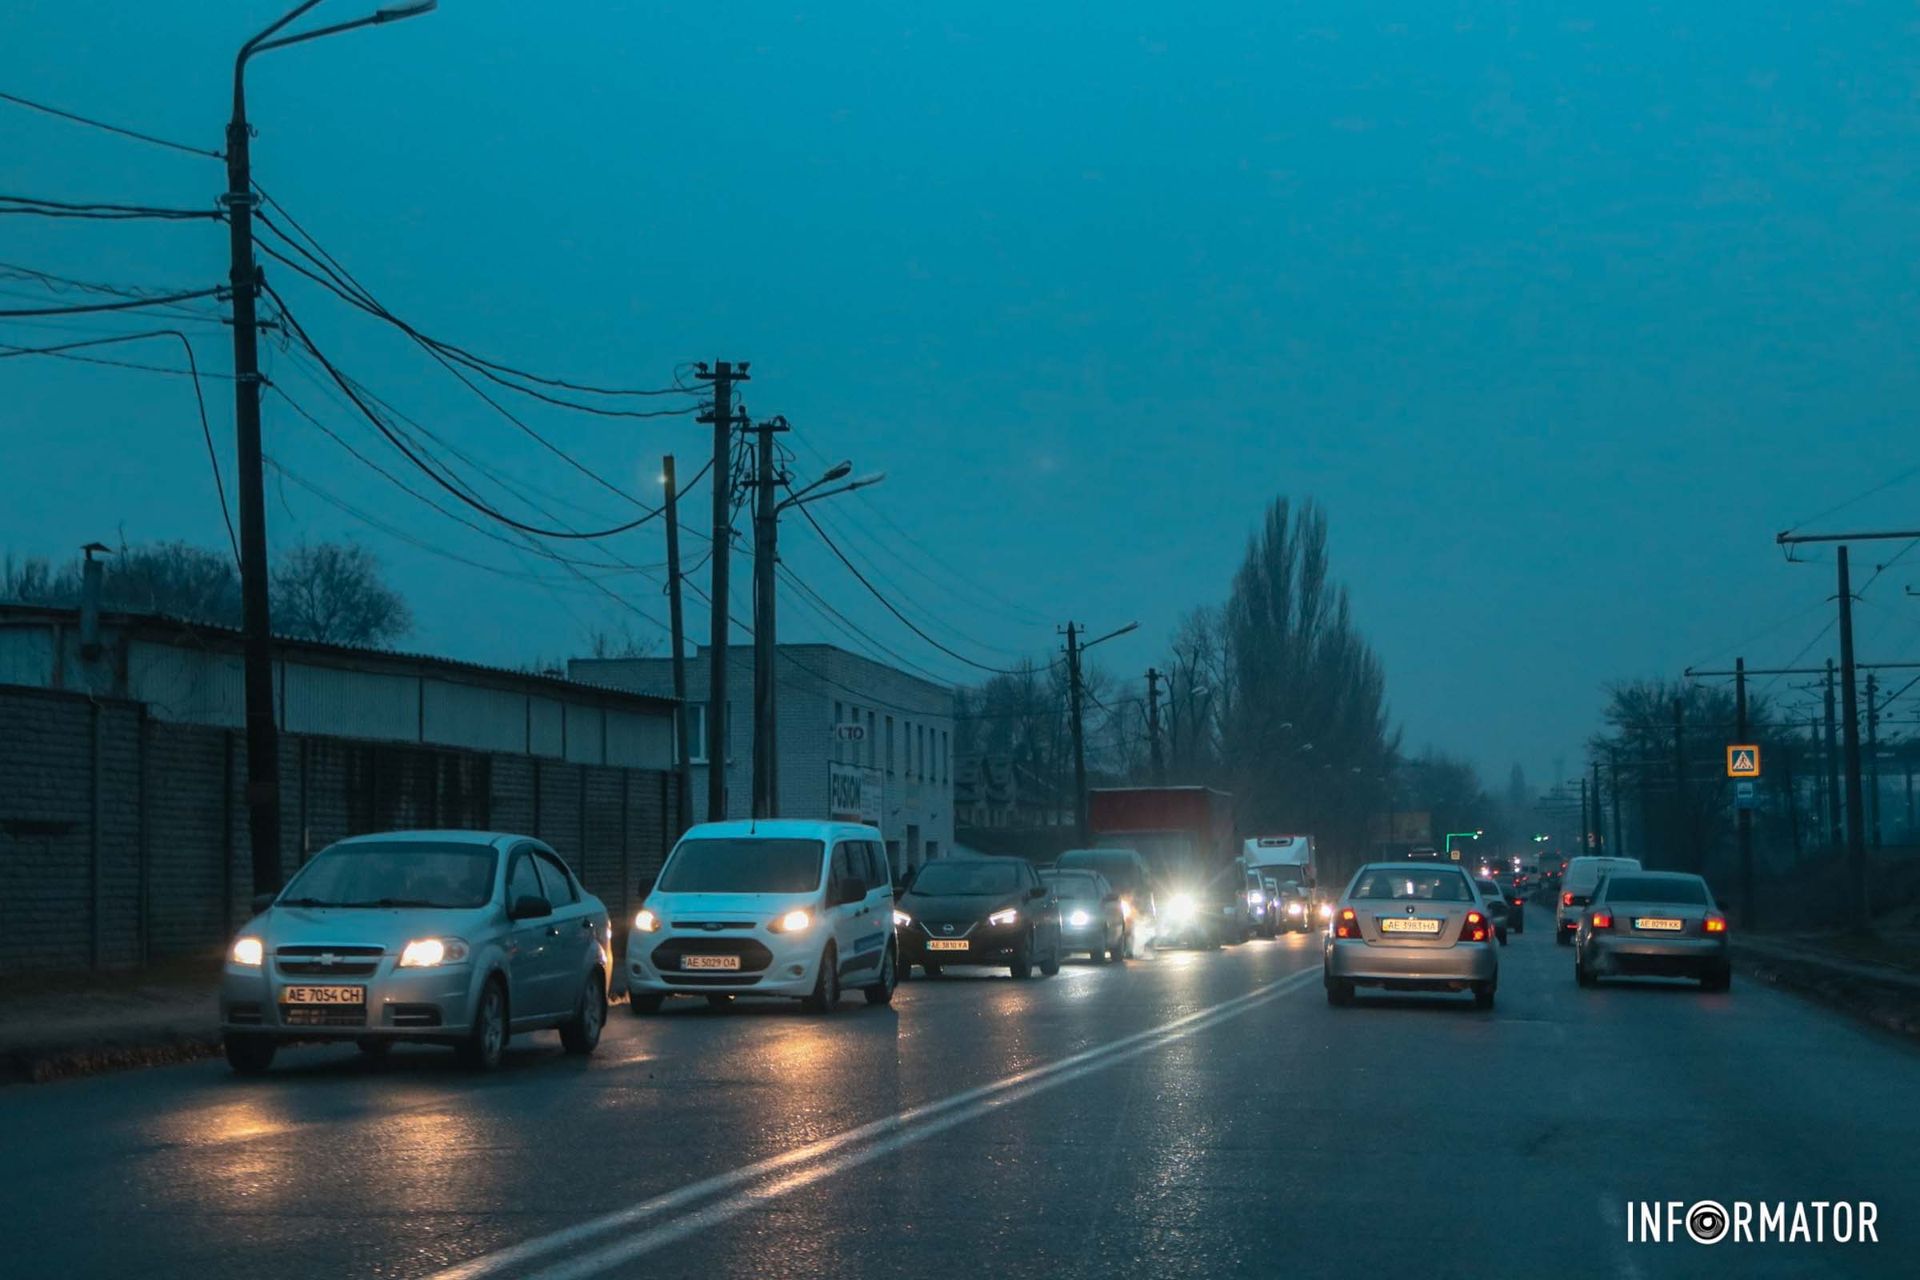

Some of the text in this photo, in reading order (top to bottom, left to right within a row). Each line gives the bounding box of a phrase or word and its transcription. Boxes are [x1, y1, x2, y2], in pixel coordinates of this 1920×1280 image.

[832, 773, 861, 810] FUSION
[687, 957, 700, 968] AE
[288, 988, 360, 1002] AE 7054 CH
